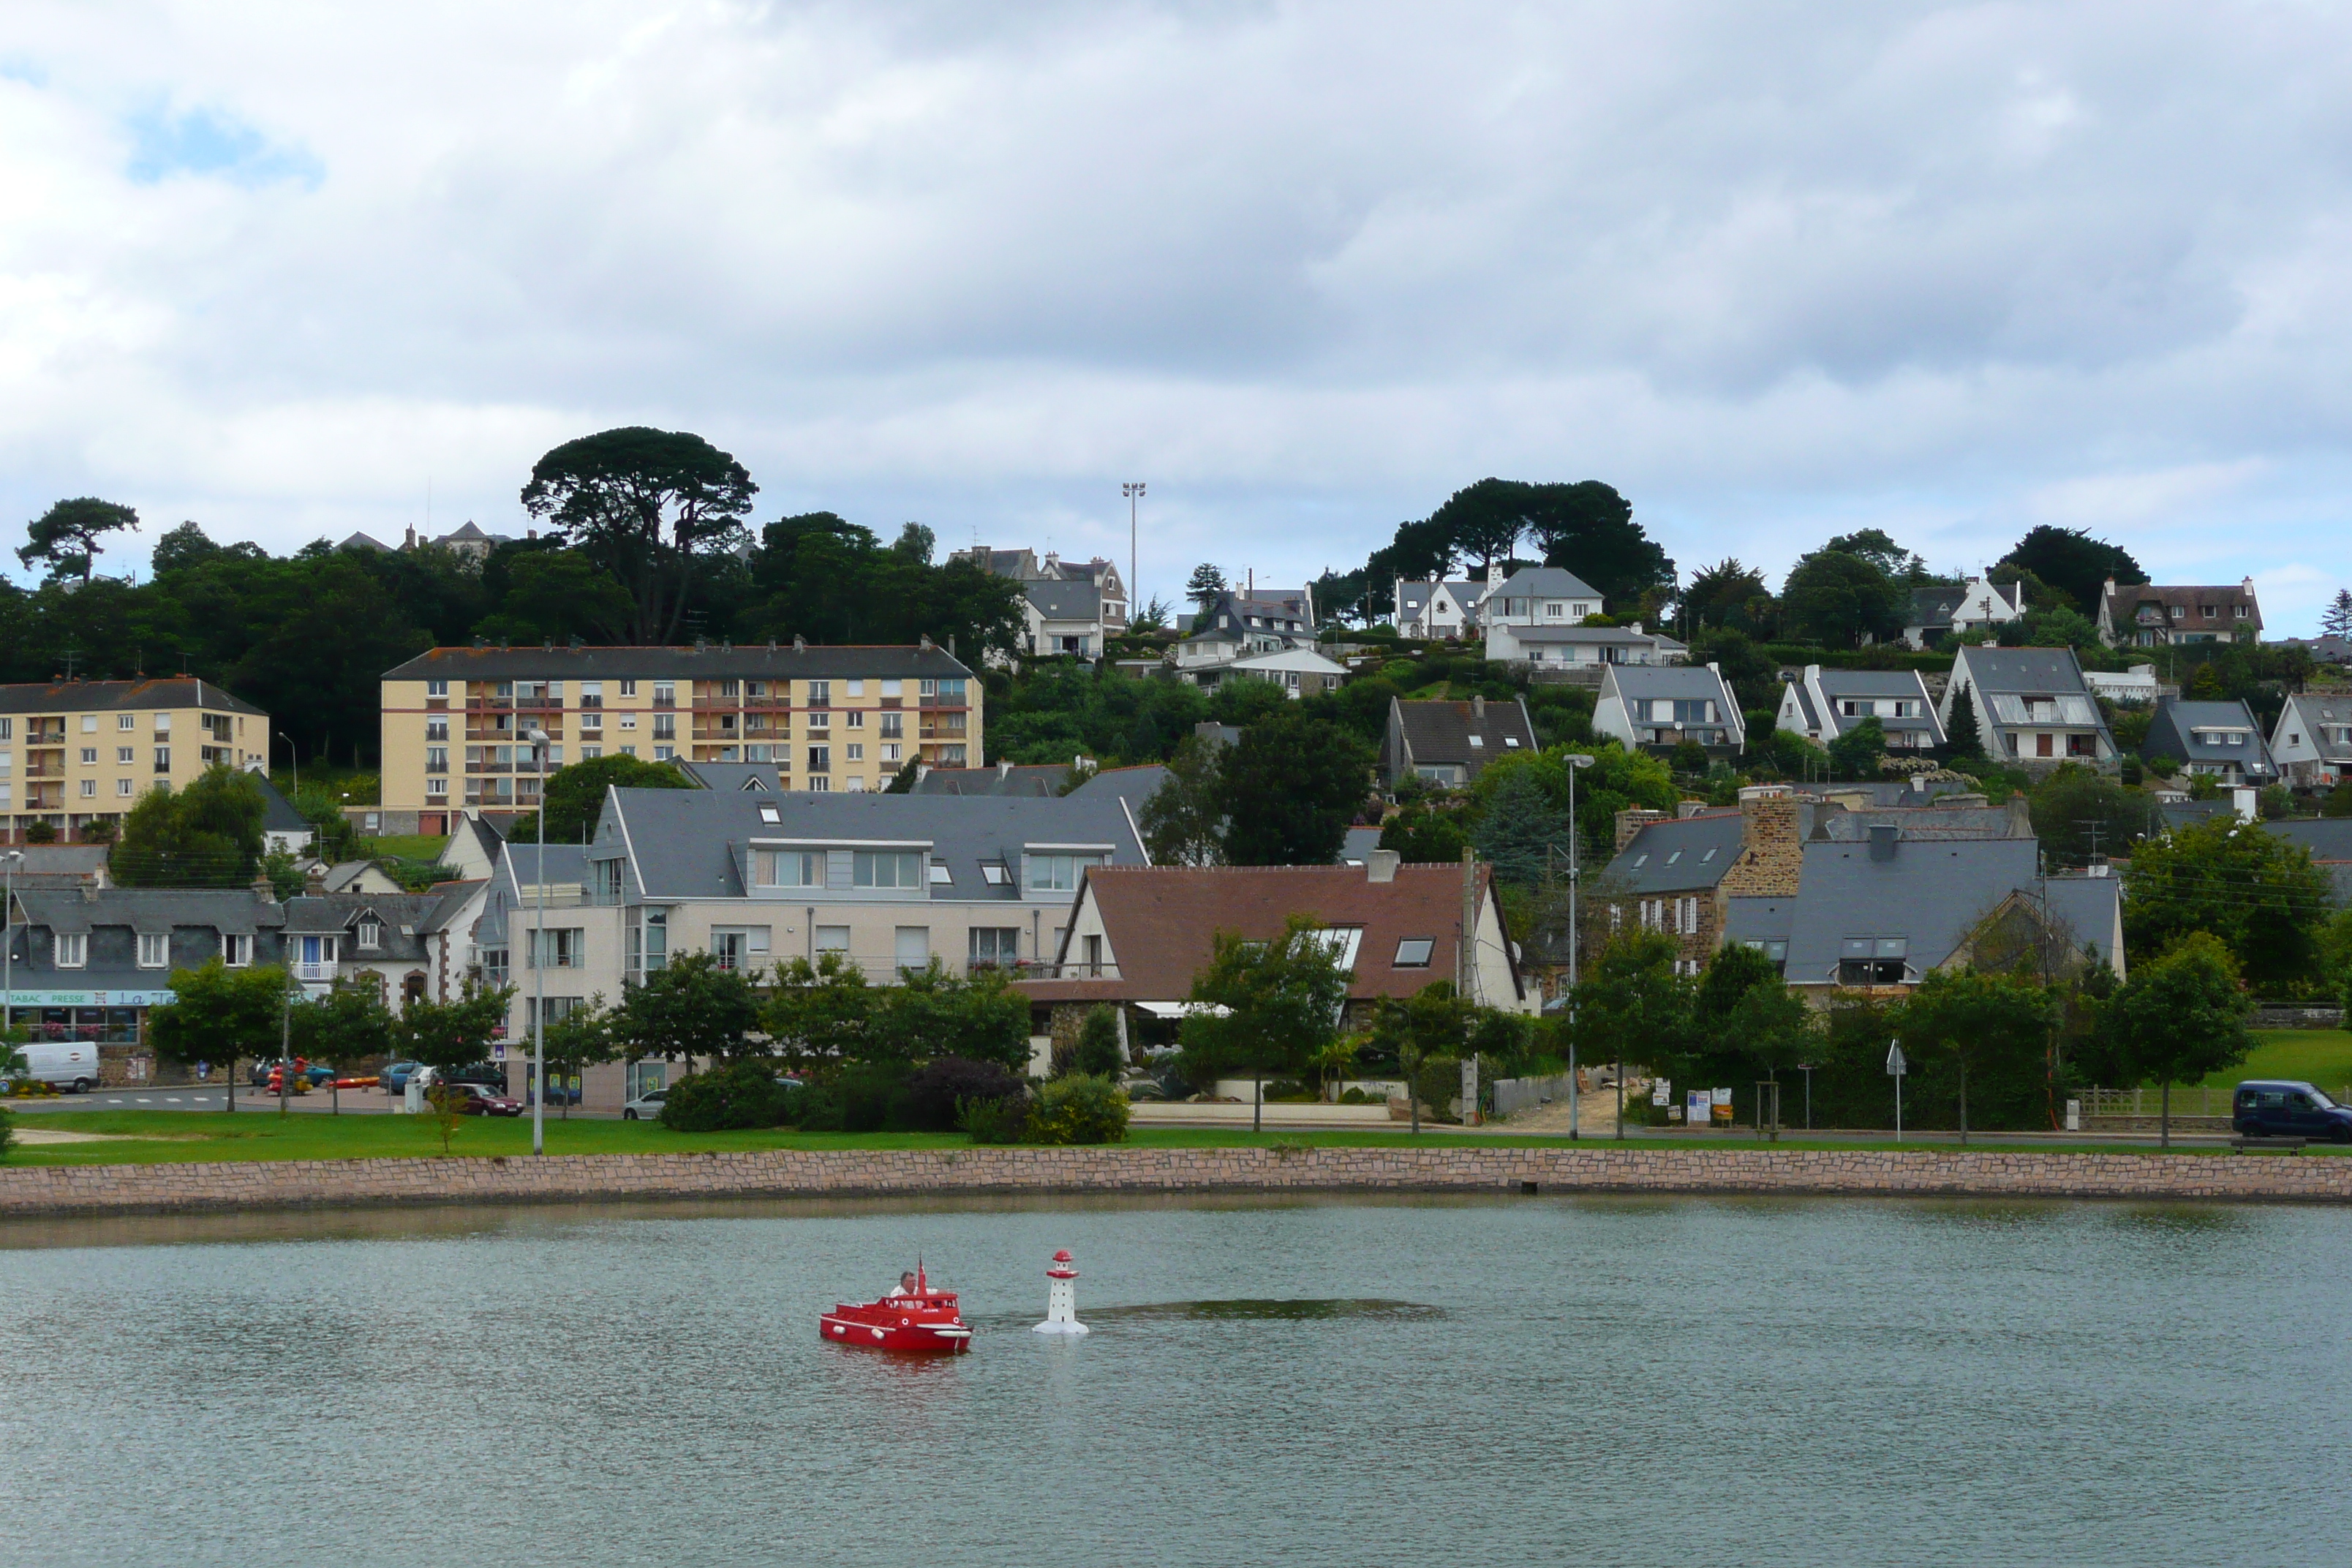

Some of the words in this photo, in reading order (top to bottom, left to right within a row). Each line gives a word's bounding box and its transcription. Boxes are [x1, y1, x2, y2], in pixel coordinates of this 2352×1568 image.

[10, 995, 42, 1003] TABAC
[51, 995, 86, 1003] PRESSE
[118, 991, 145, 1005] La
